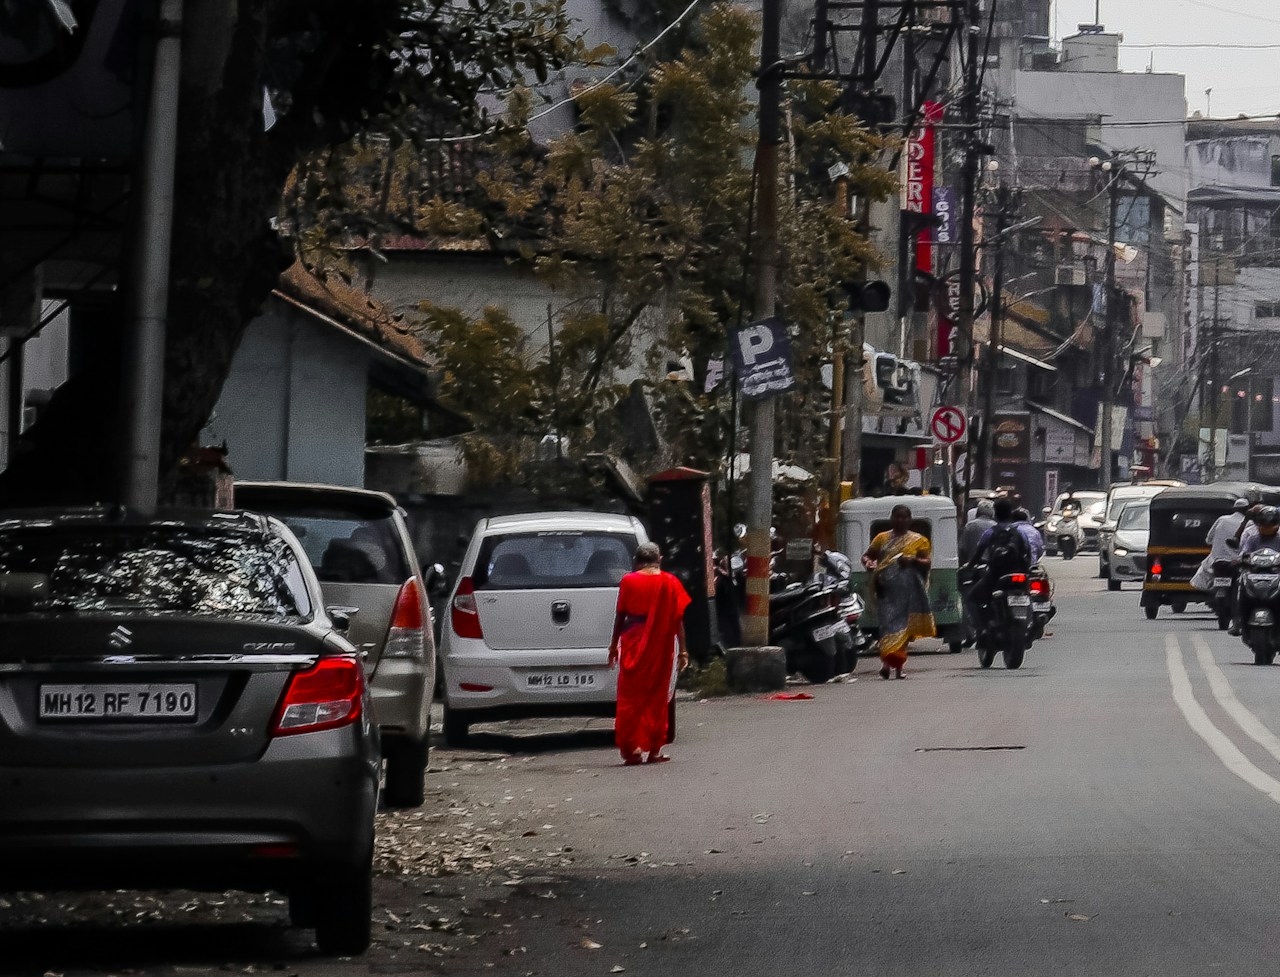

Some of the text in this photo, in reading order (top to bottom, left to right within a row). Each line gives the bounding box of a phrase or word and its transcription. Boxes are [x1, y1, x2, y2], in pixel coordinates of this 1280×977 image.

[908, 104, 926, 213] ODERN
[737, 324, 774, 366] P
[103, 692, 131, 714] RF
[137, 691, 193, 714] 7190
